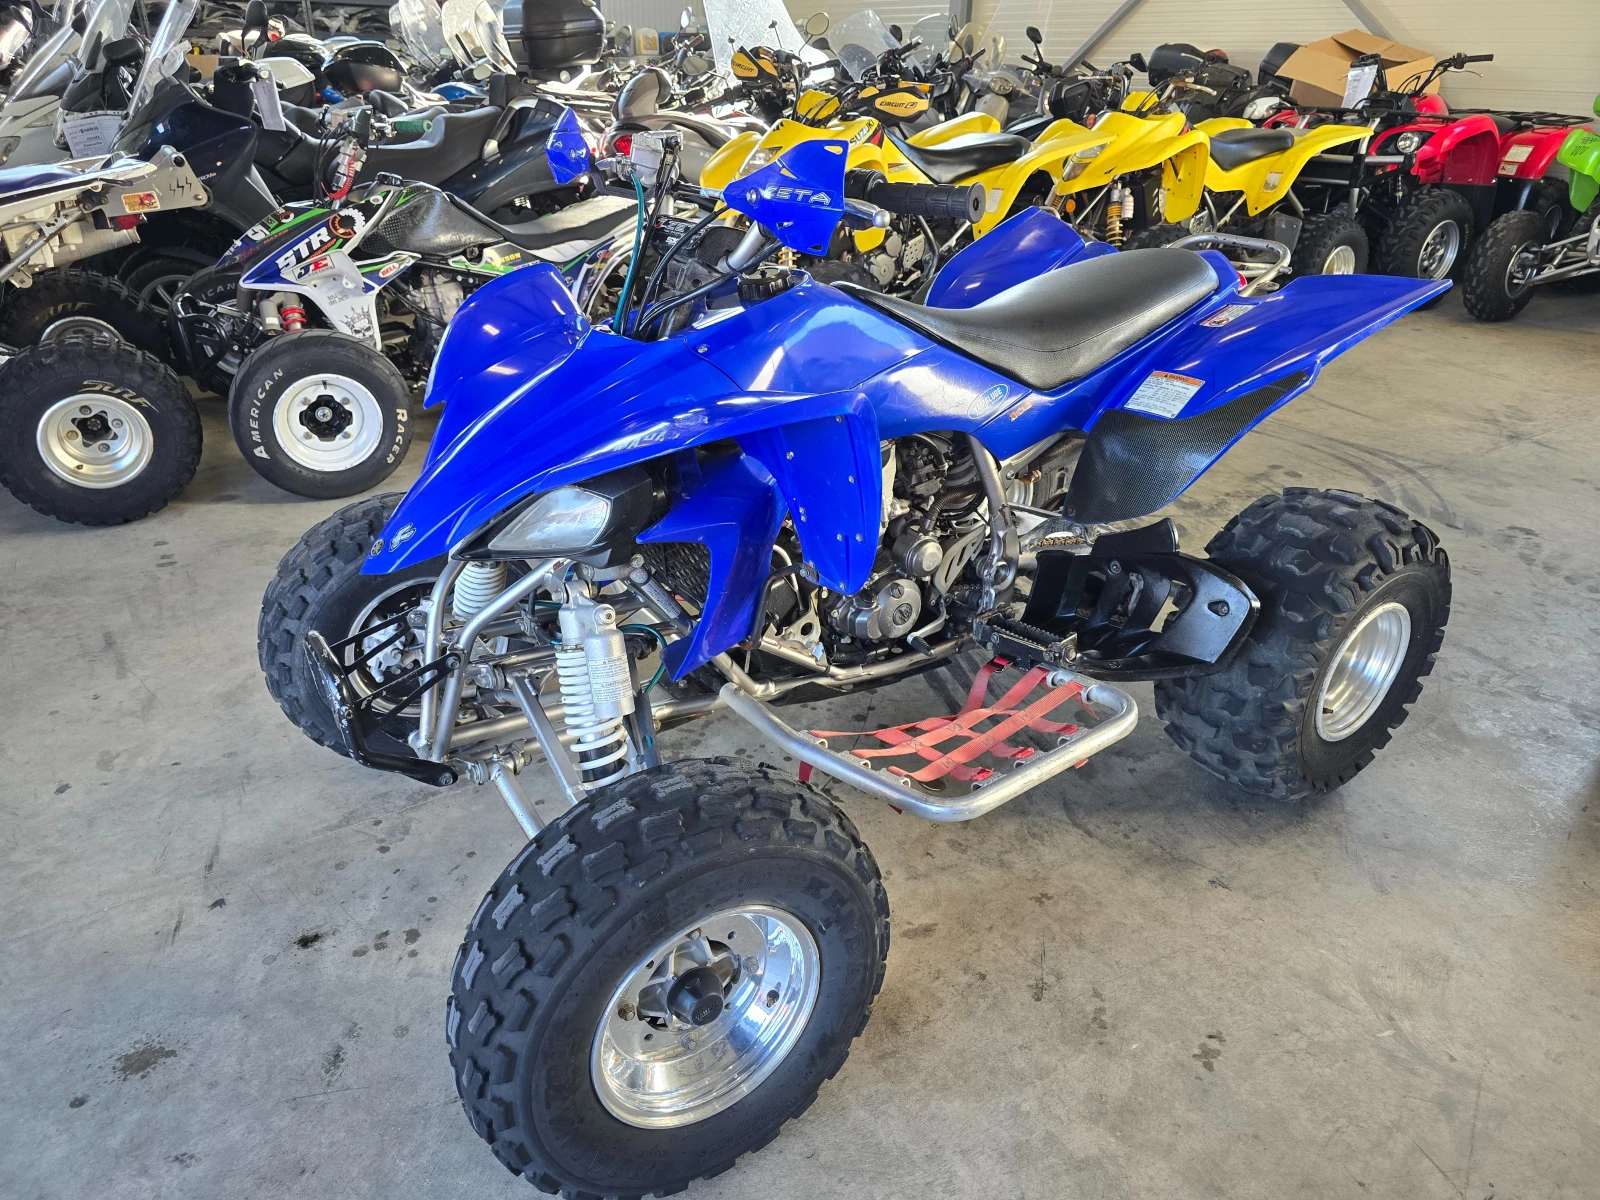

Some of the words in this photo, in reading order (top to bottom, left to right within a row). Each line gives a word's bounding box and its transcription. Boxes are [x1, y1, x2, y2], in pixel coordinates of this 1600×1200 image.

[850, 119, 875, 146] SUZUKI
[275, 226, 332, 275] STR
[297, 257, 330, 280] JE
[381, 264, 398, 277] BELL
[250, 367, 285, 460] AMERICAN
[386, 408, 408, 464] RACER
